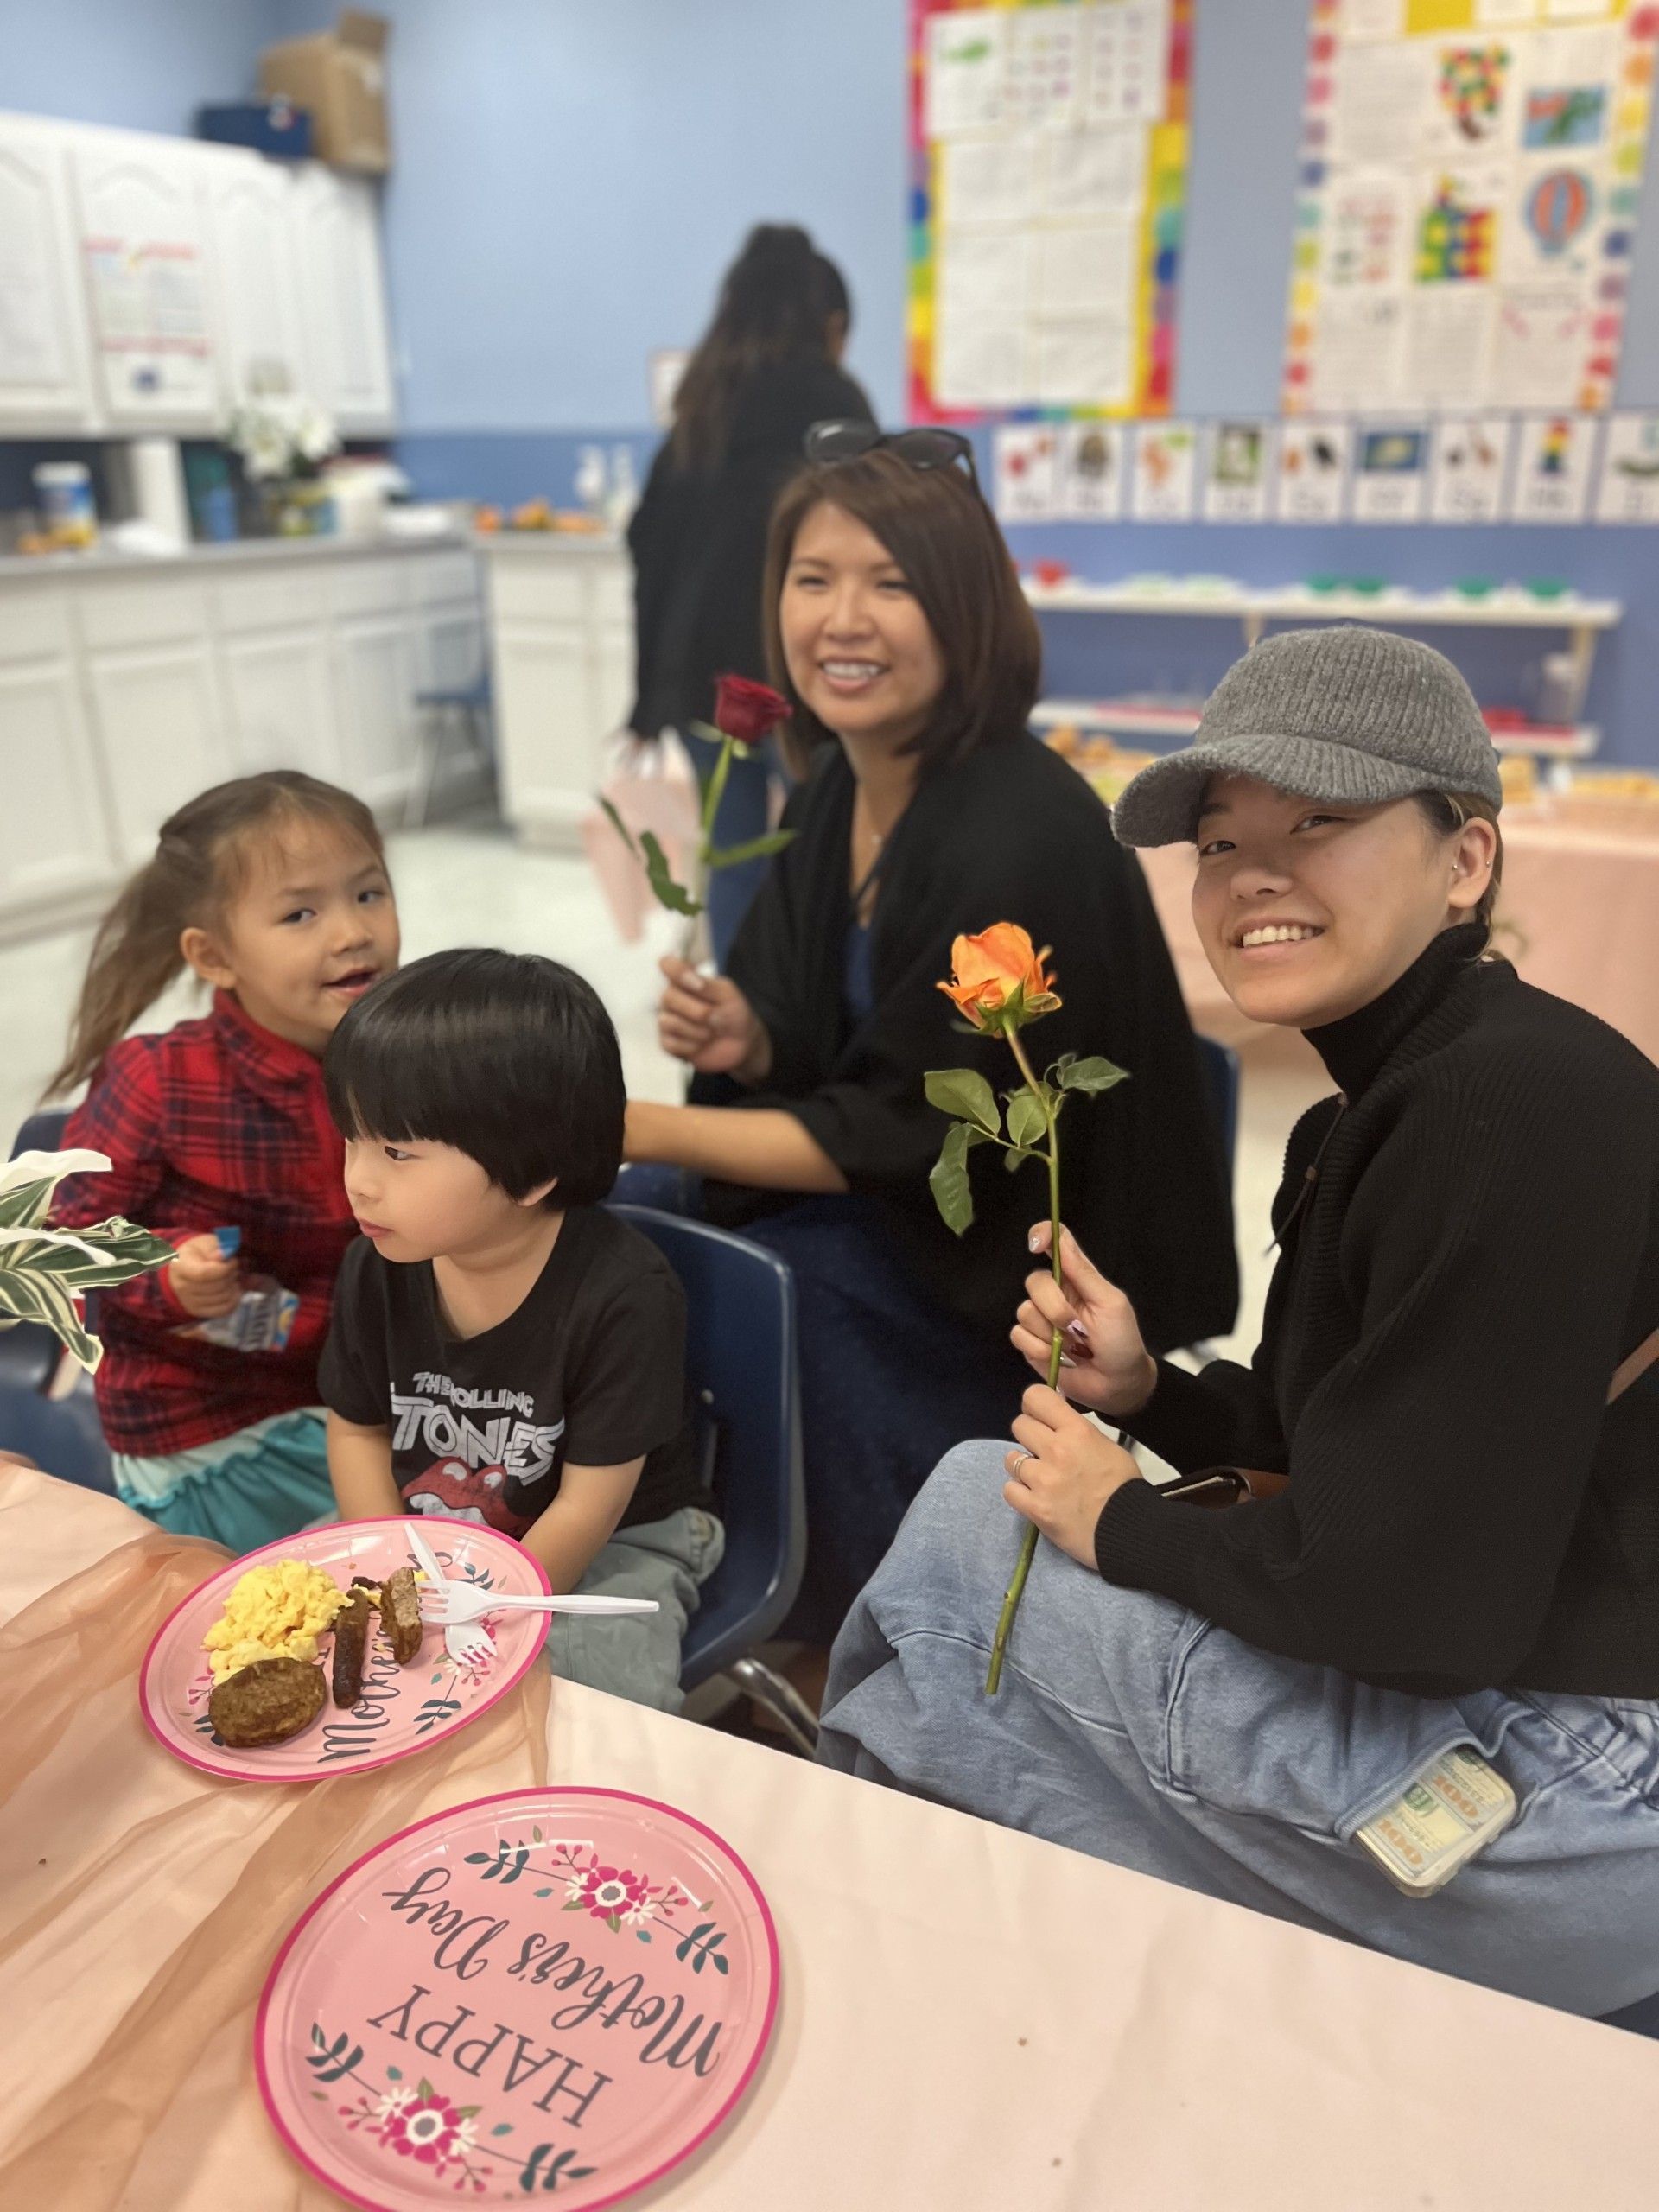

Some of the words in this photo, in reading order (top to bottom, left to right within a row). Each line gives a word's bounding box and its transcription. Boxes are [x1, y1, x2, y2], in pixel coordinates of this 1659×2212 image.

[390, 1382, 565, 1486] TONES
[412, 1370, 451, 1395] THE
[449, 1384, 534, 1418] OLLING
[382, 1867, 510, 1980] Day
[367, 1984, 613, 2129] HAPPY
[507, 1932, 723, 2078] Mother's
